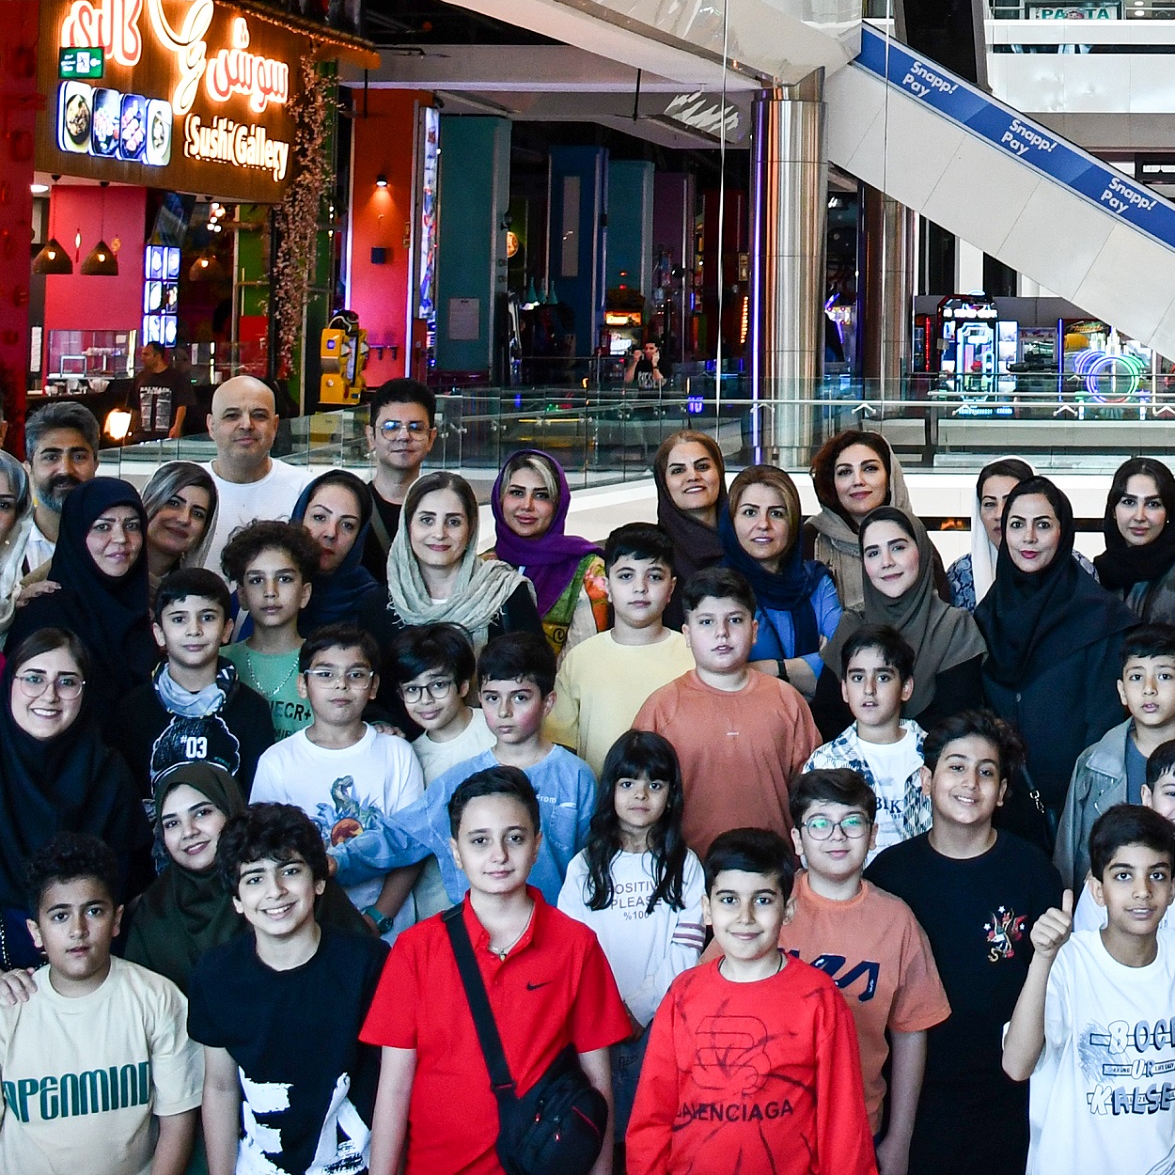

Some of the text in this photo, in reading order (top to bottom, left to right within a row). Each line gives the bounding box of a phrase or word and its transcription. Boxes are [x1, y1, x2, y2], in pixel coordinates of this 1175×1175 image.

[1041, 9, 1110, 20] PATA
[902, 73, 931, 98] Pay
[910, 61, 960, 95] Snapp!
[187, 115, 290, 182] Sushi Gallery
[1001, 131, 1030, 156] Pay
[1009, 119, 1058, 153] Snapp!
[1100, 190, 1129, 214] Pay
[1108, 177, 1158, 211] Snapp!
